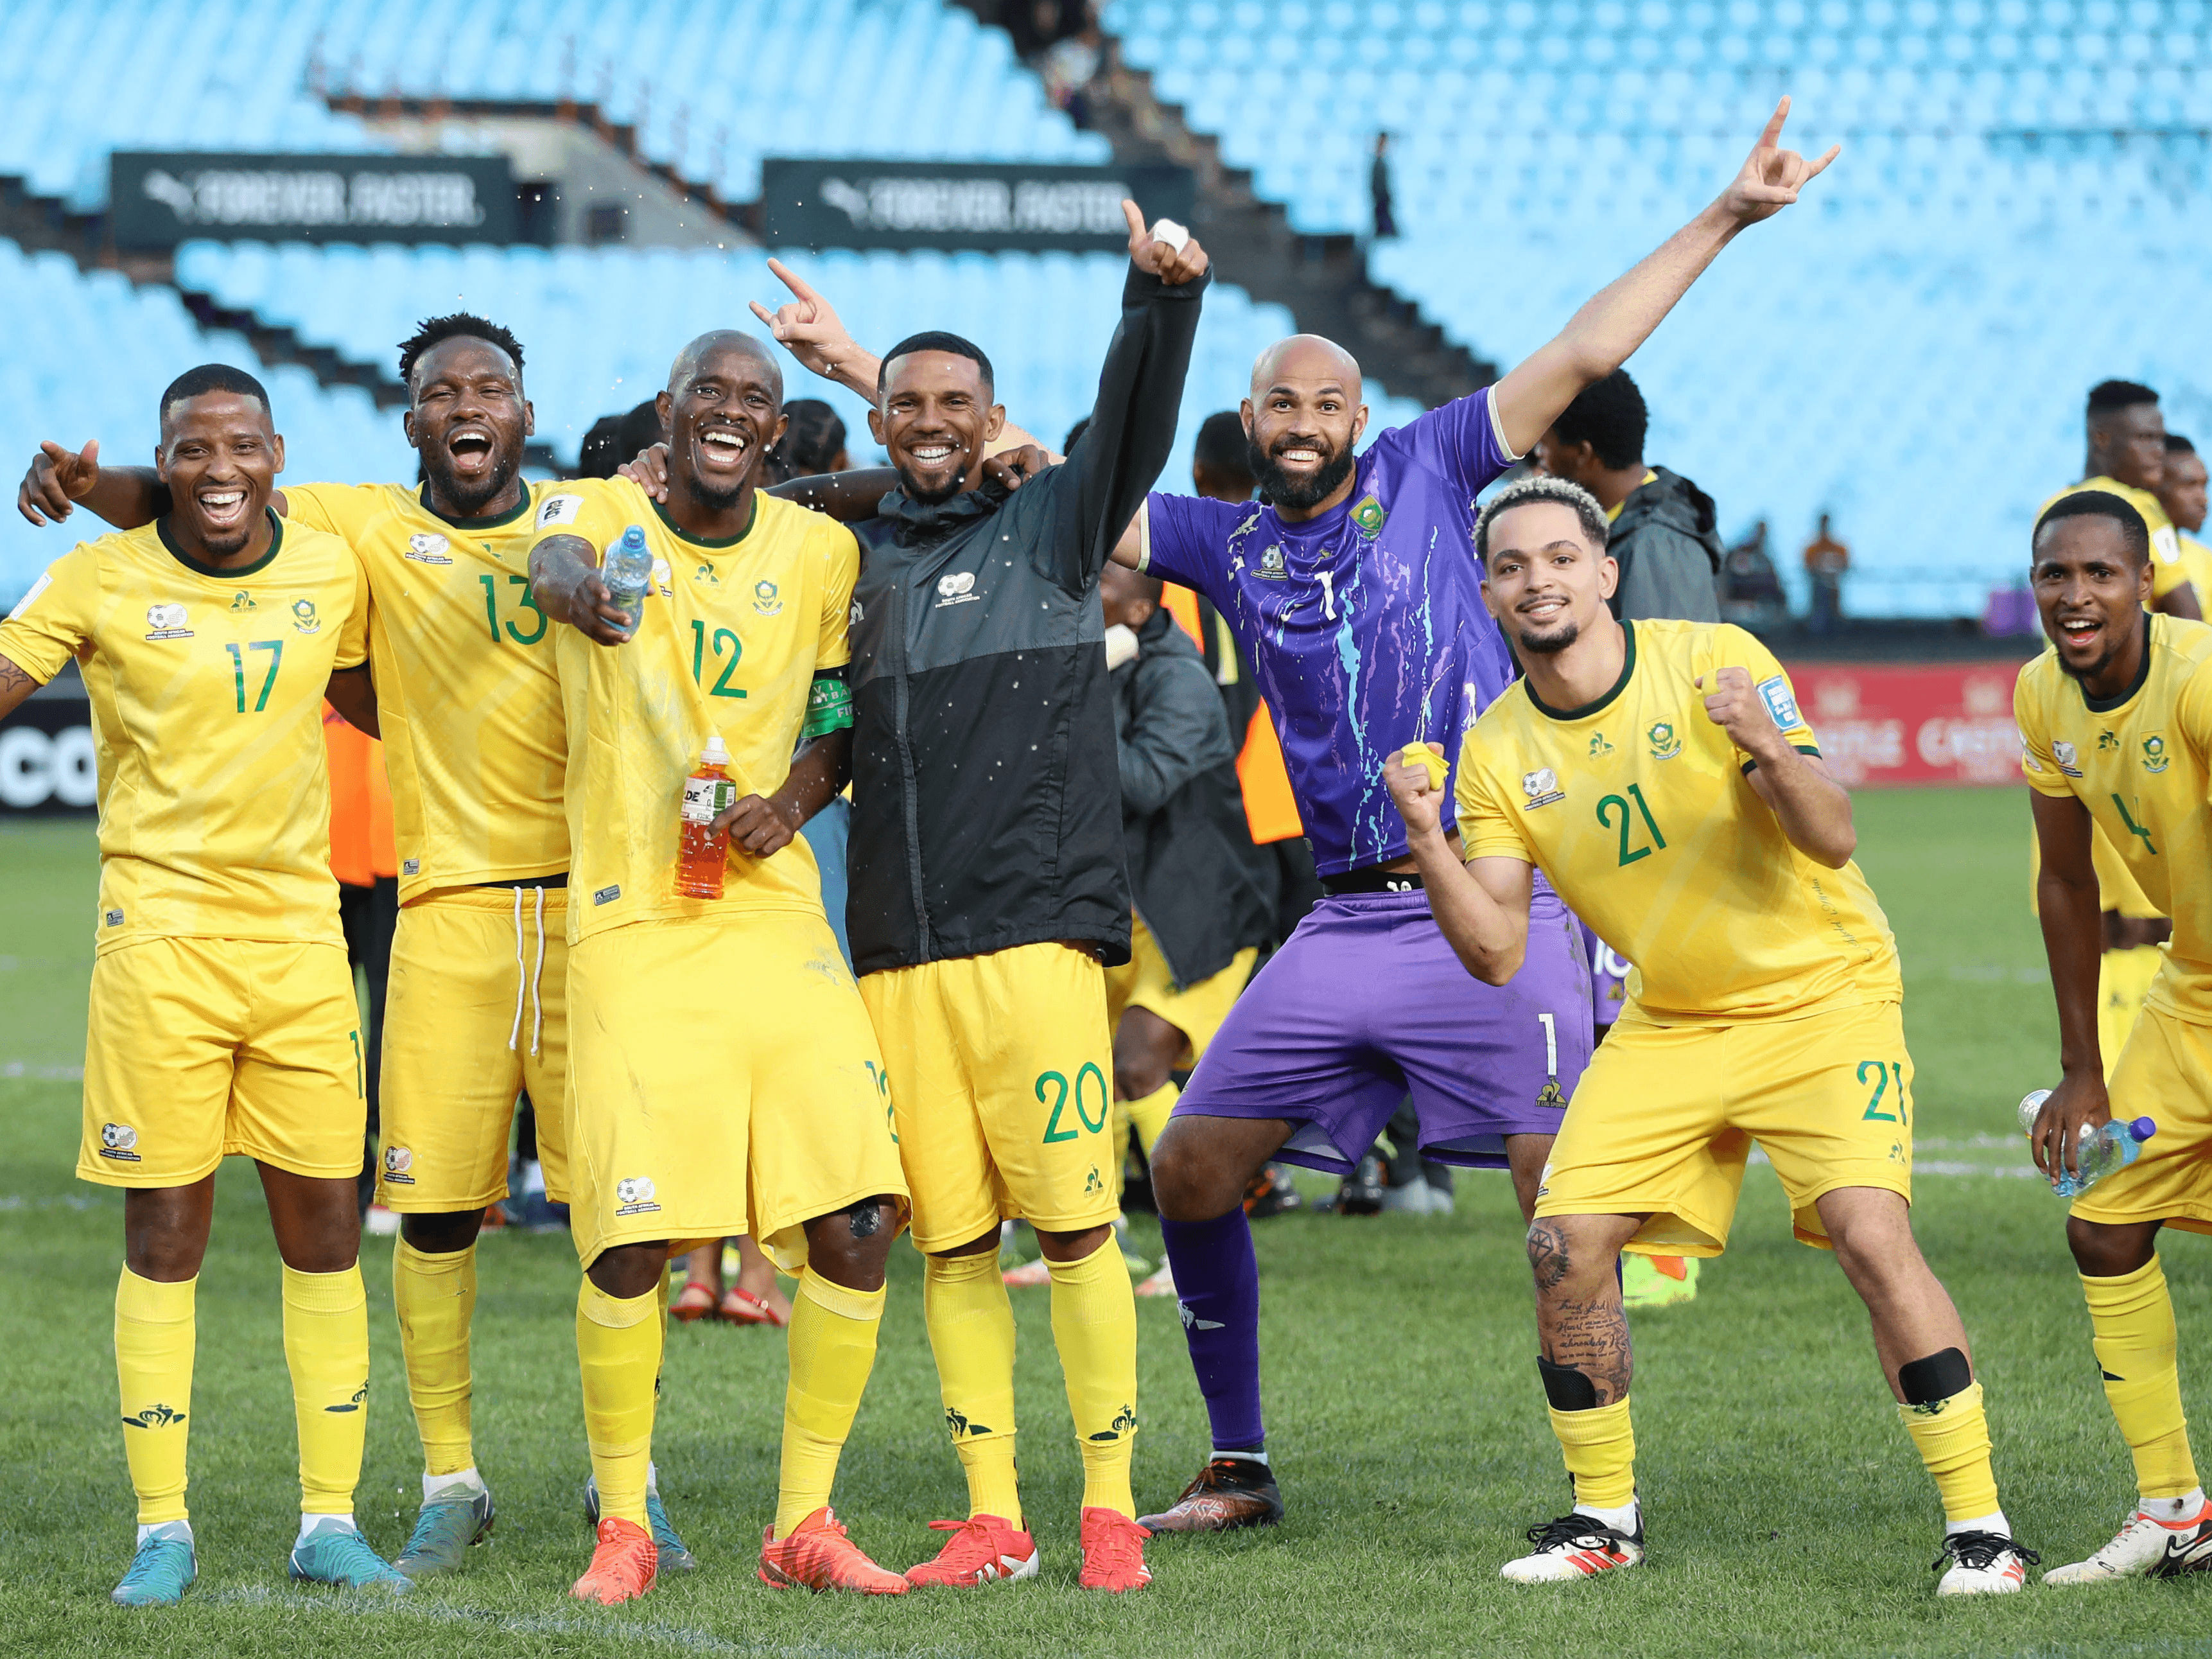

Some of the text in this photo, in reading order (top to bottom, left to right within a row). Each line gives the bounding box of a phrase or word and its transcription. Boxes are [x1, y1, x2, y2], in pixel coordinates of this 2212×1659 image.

[479, 575, 548, 645] 13
[1314, 570, 1337, 620] 1
[225, 640, 283, 713] 17
[691, 619, 747, 699] 12
[1596, 782, 1667, 866] 21
[2111, 793, 2157, 855] 4
[1538, 1013, 1557, 1075] 1
[1034, 1061, 1108, 1143] 20
[1856, 1060, 1907, 1127] 21
